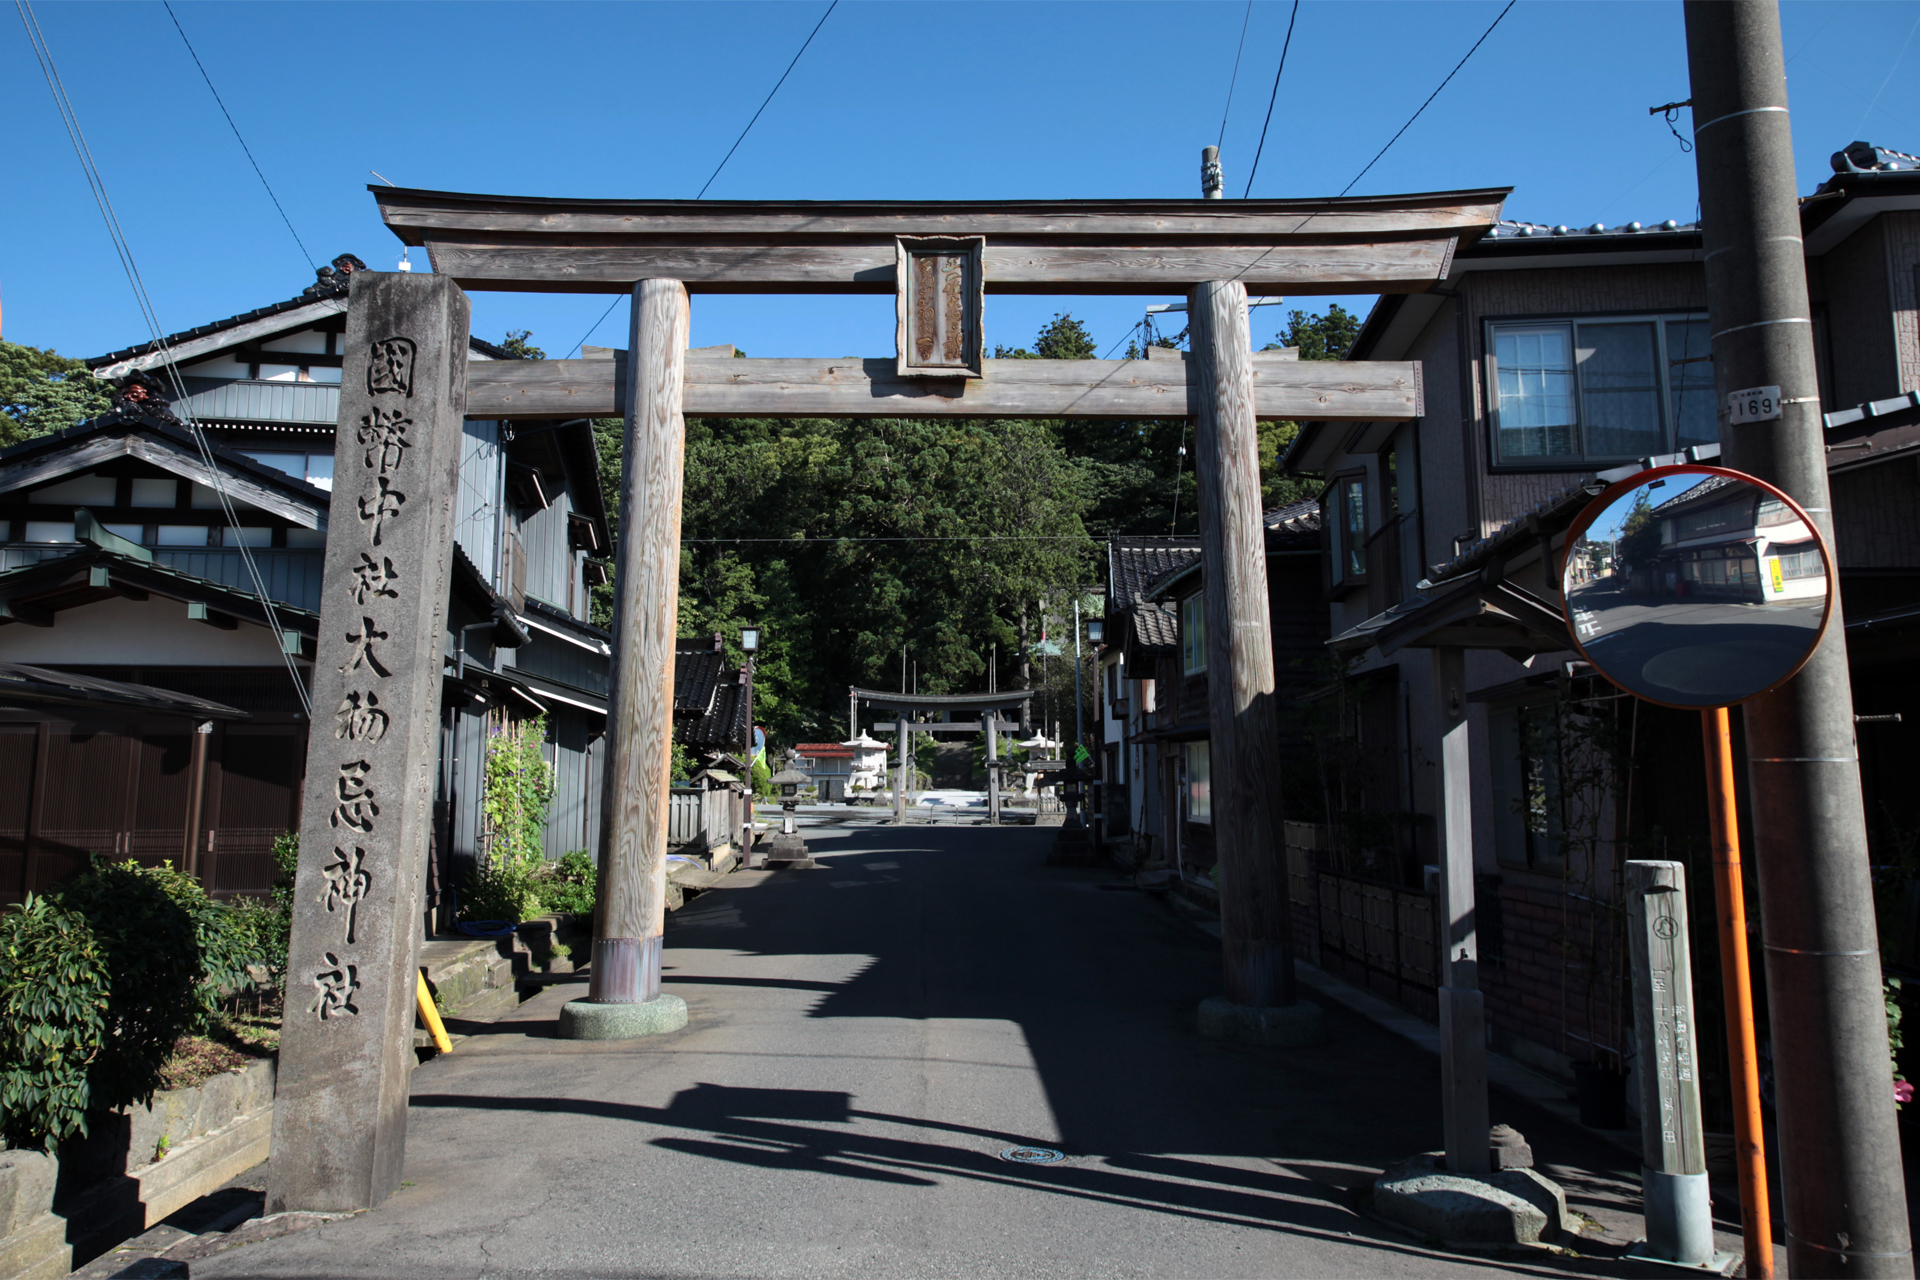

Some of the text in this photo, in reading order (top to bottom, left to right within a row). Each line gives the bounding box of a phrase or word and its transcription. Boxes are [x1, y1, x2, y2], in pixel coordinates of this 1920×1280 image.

[1739, 398, 1772, 416] 169
[307, 336, 418, 1022] 國幣中社大物忌神社
